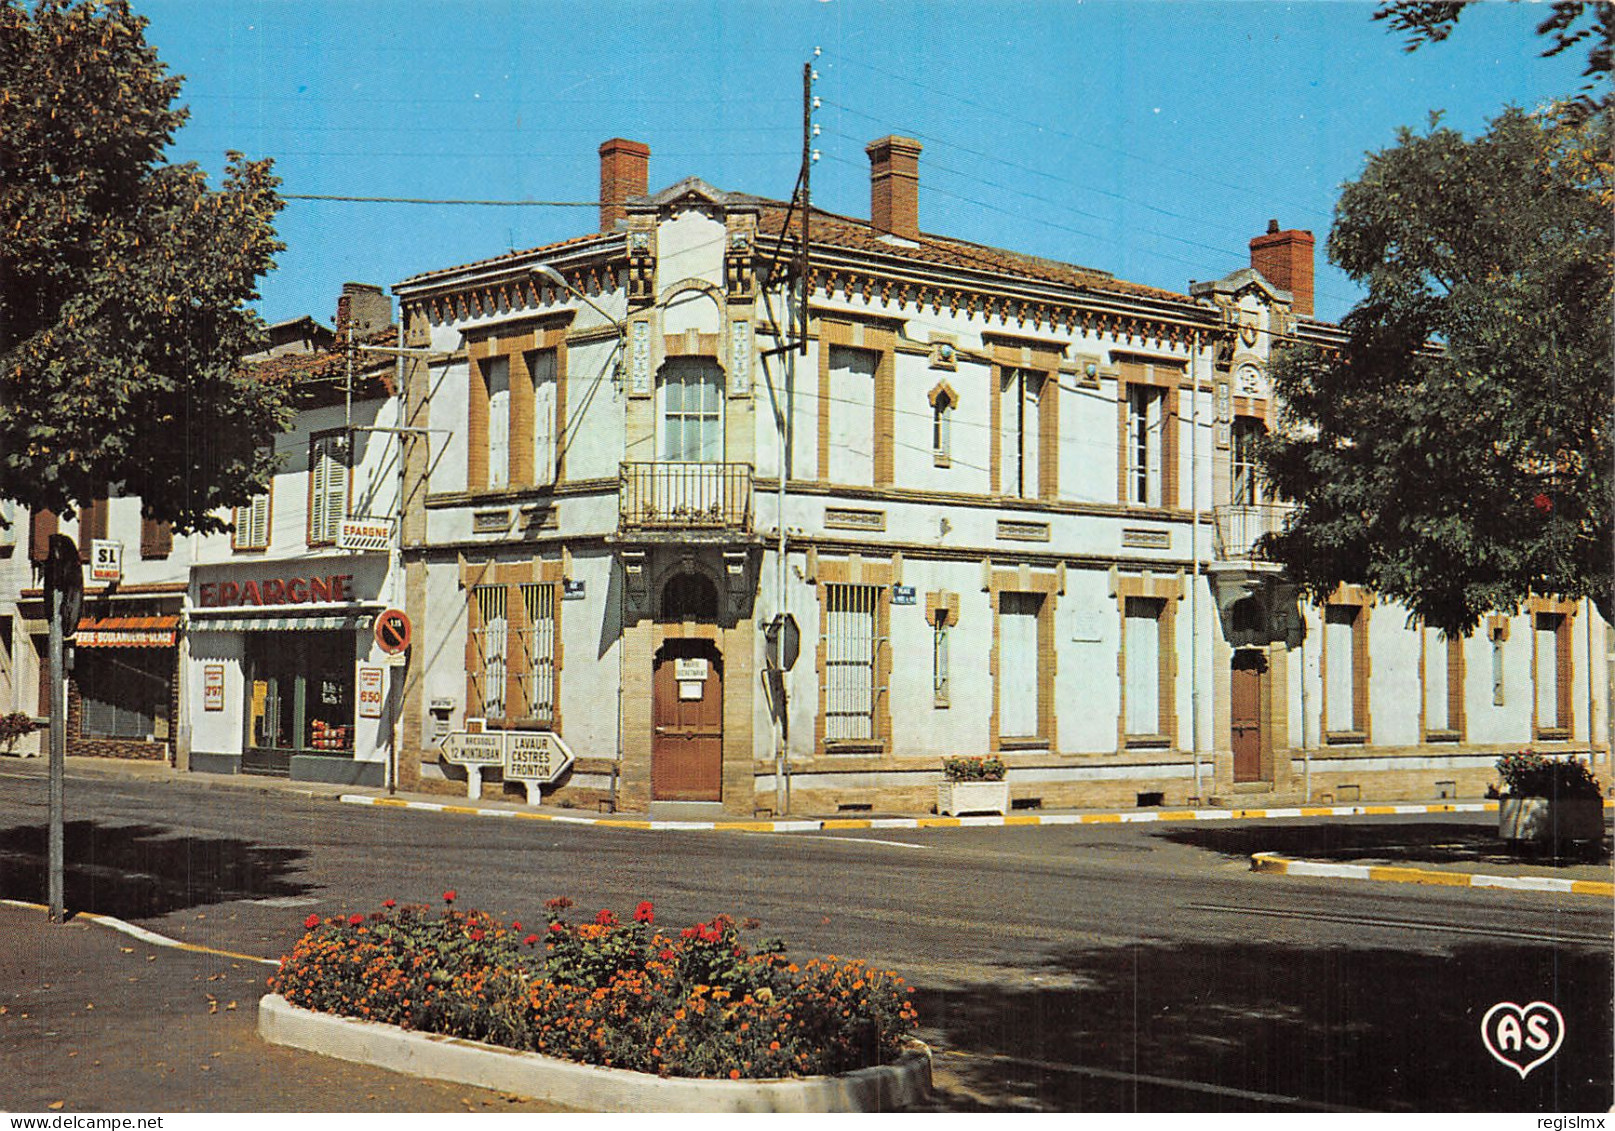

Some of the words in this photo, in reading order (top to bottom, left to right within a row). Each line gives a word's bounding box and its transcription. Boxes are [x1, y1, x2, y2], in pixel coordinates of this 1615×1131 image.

[343, 525, 388, 538] EPARGNE
[199, 574, 354, 608] EPARGNE
[465, 737, 496, 746] BRESSOLS
[514, 738, 548, 750] LAVAUR
[451, 748, 459, 759] 12
[460, 748, 500, 760] MONTAUBAN
[512, 751, 551, 763] CASTRES
[512, 764, 551, 777] FRONTON
